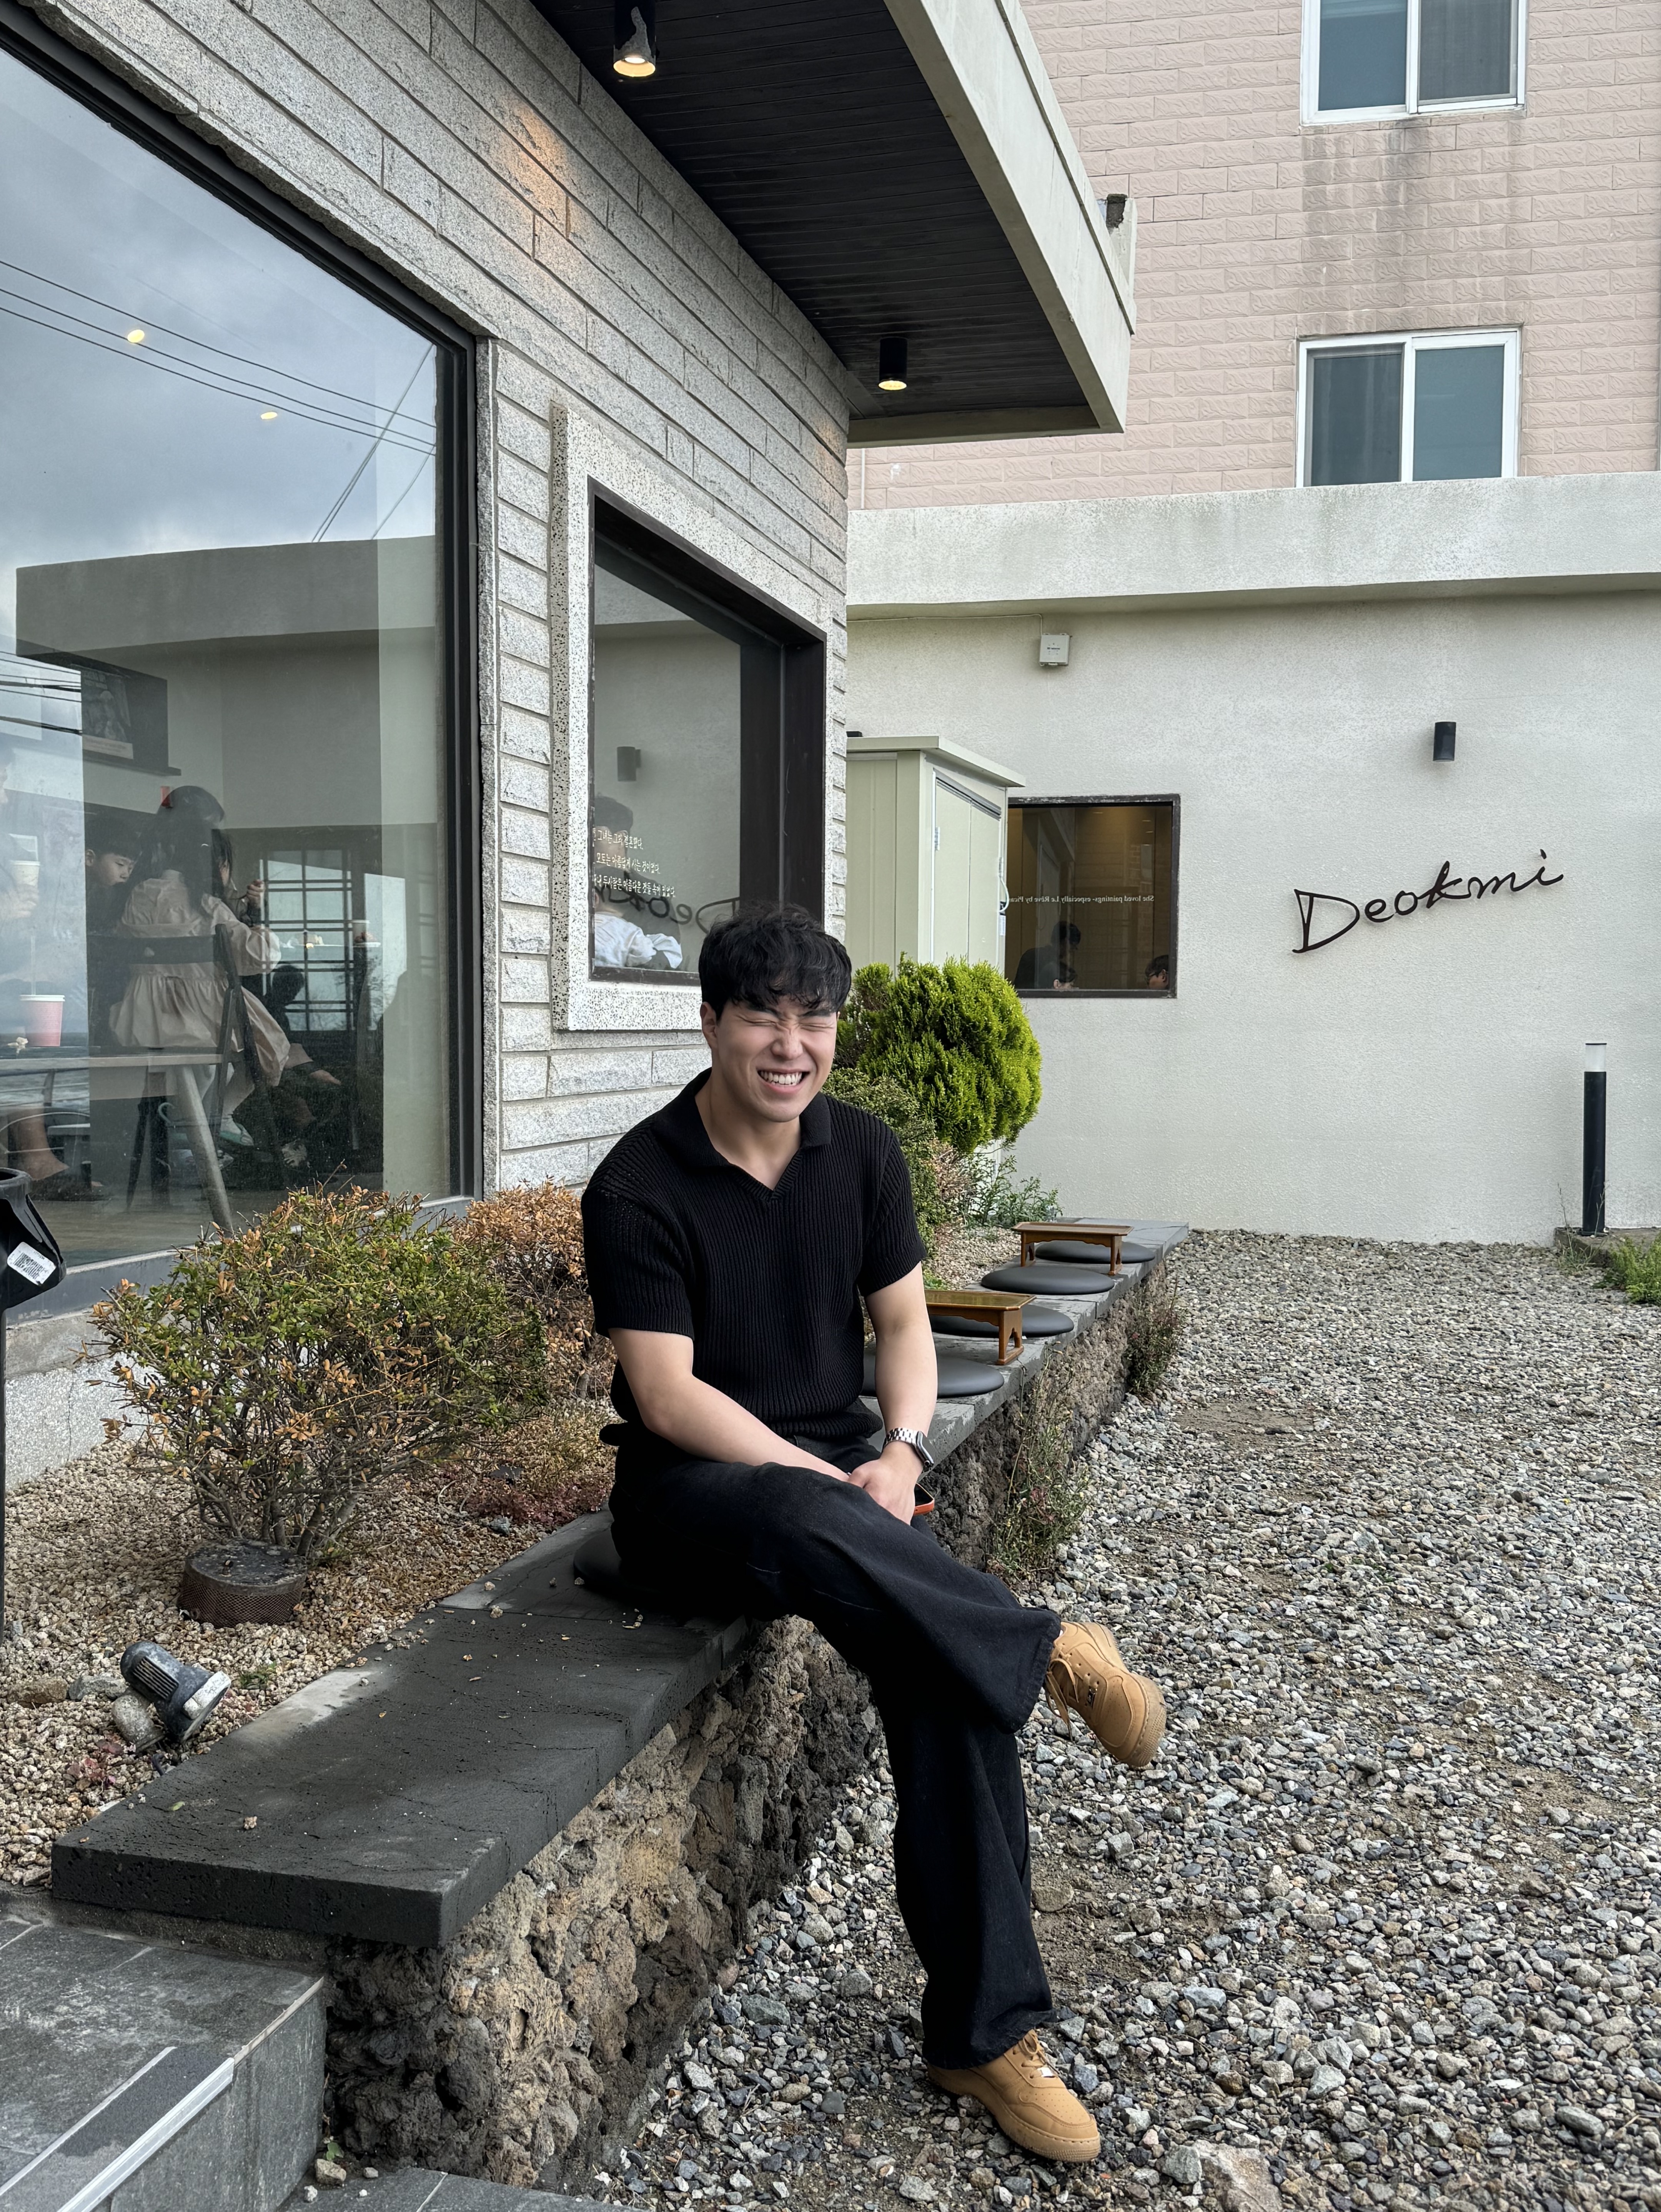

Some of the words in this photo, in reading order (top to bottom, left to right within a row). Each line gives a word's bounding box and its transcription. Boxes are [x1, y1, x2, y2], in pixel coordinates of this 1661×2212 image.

[597, 830, 612, 844] 그녀는
[623, 879, 641, 893] 아름다운
[1292, 849, 1564, 953] Deokmi
